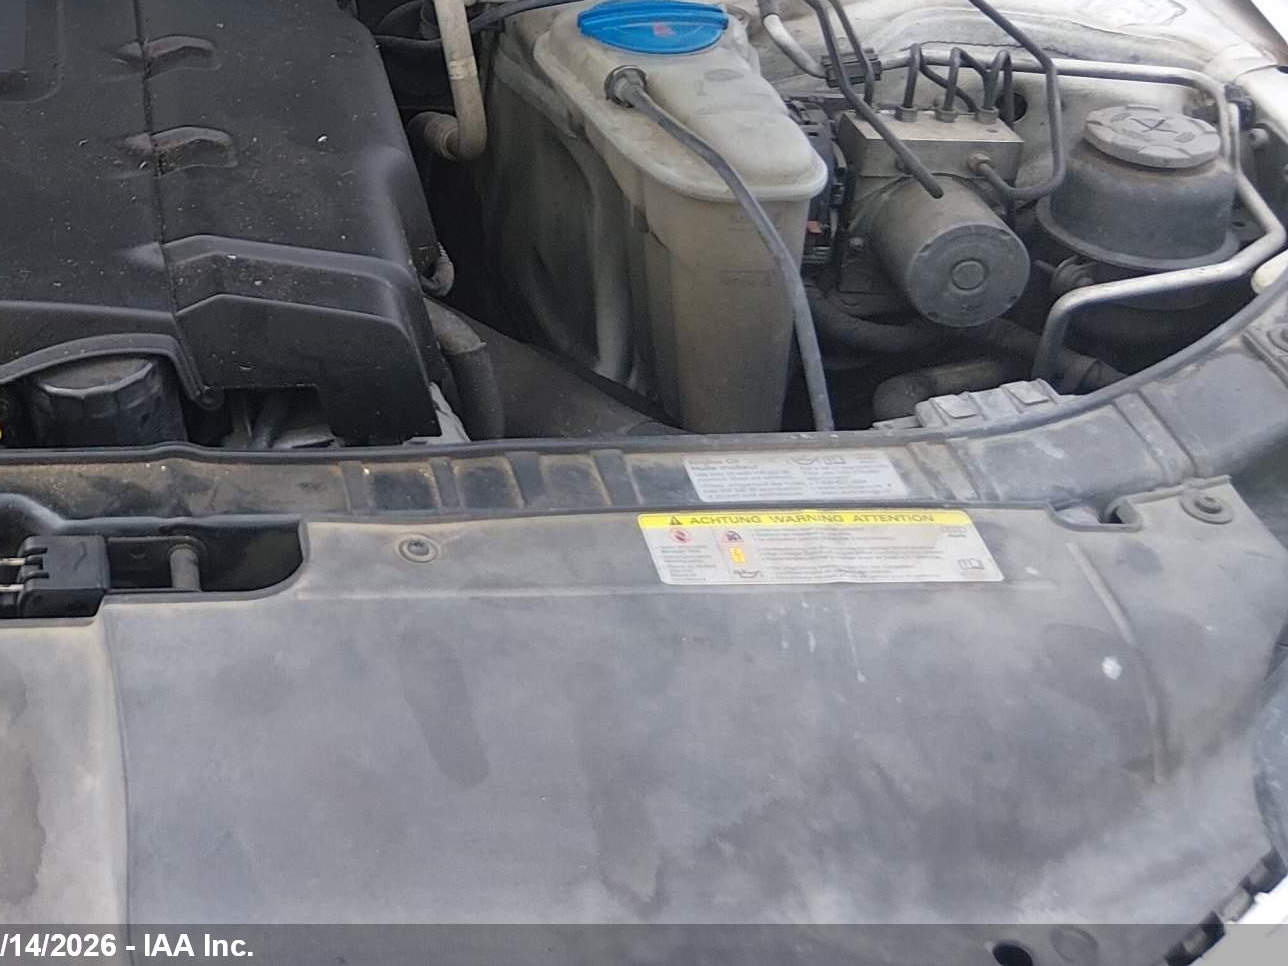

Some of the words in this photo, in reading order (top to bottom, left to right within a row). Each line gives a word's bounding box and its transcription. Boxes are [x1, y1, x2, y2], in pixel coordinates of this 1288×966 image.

[690, 515, 761, 525] ACHTUNG
[770, 514, 844, 524] WARNING
[853, 513, 935, 523] ATTENTION
